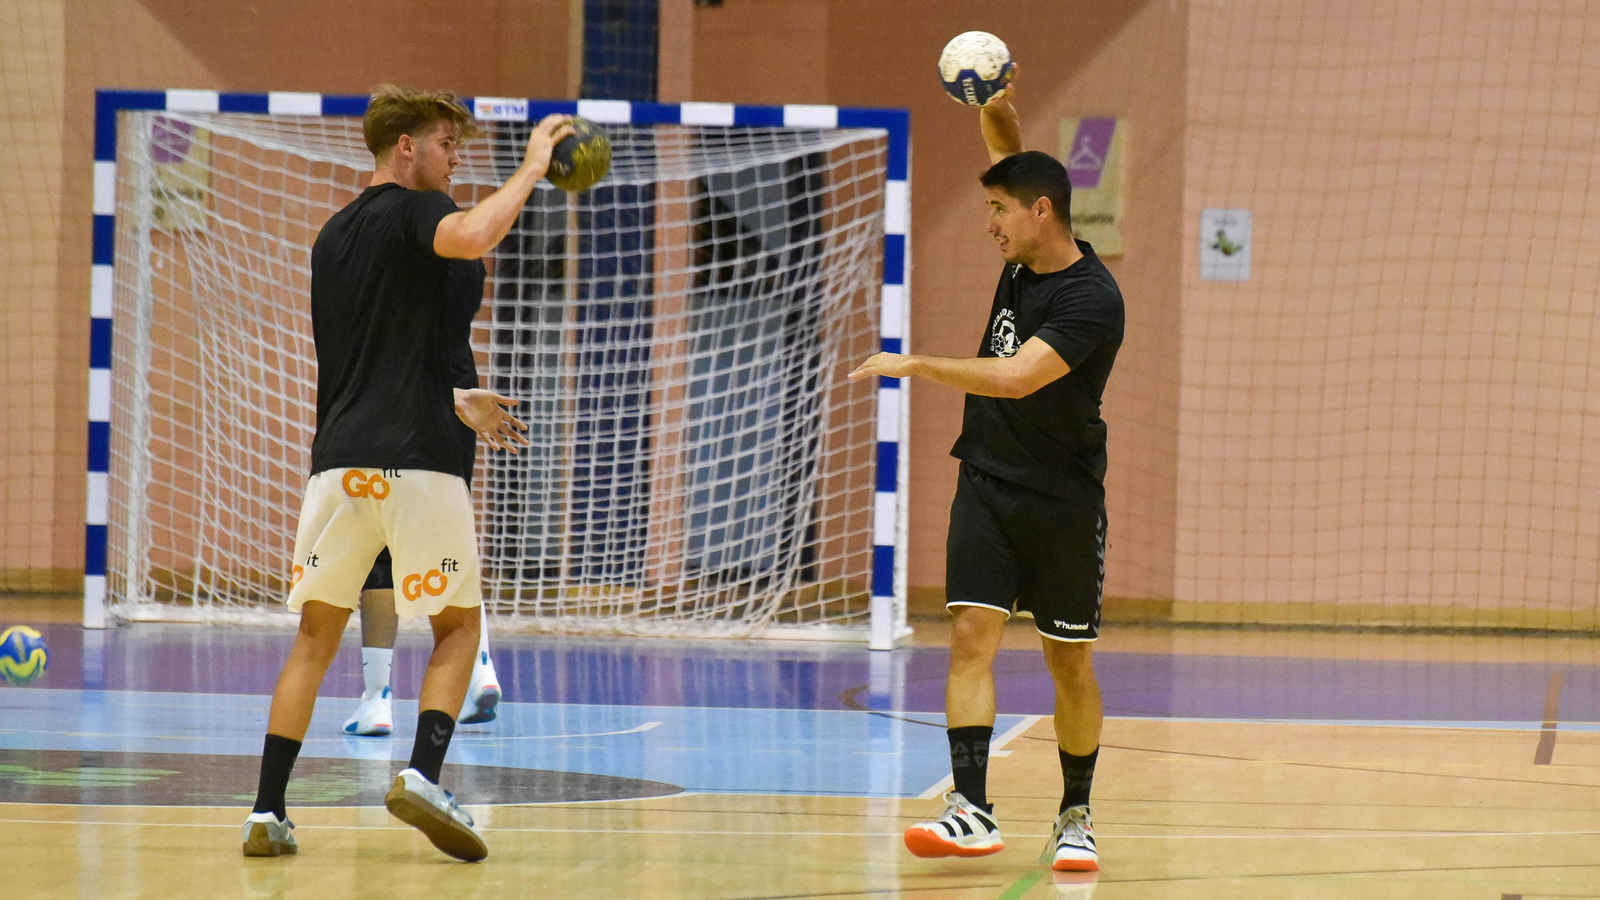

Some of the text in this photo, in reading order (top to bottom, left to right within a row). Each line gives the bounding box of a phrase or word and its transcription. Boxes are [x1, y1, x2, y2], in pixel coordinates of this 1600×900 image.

[342, 469, 390, 500] GO
[402, 558, 459, 602] GO fit
[1062, 620, 1089, 630] hummel
